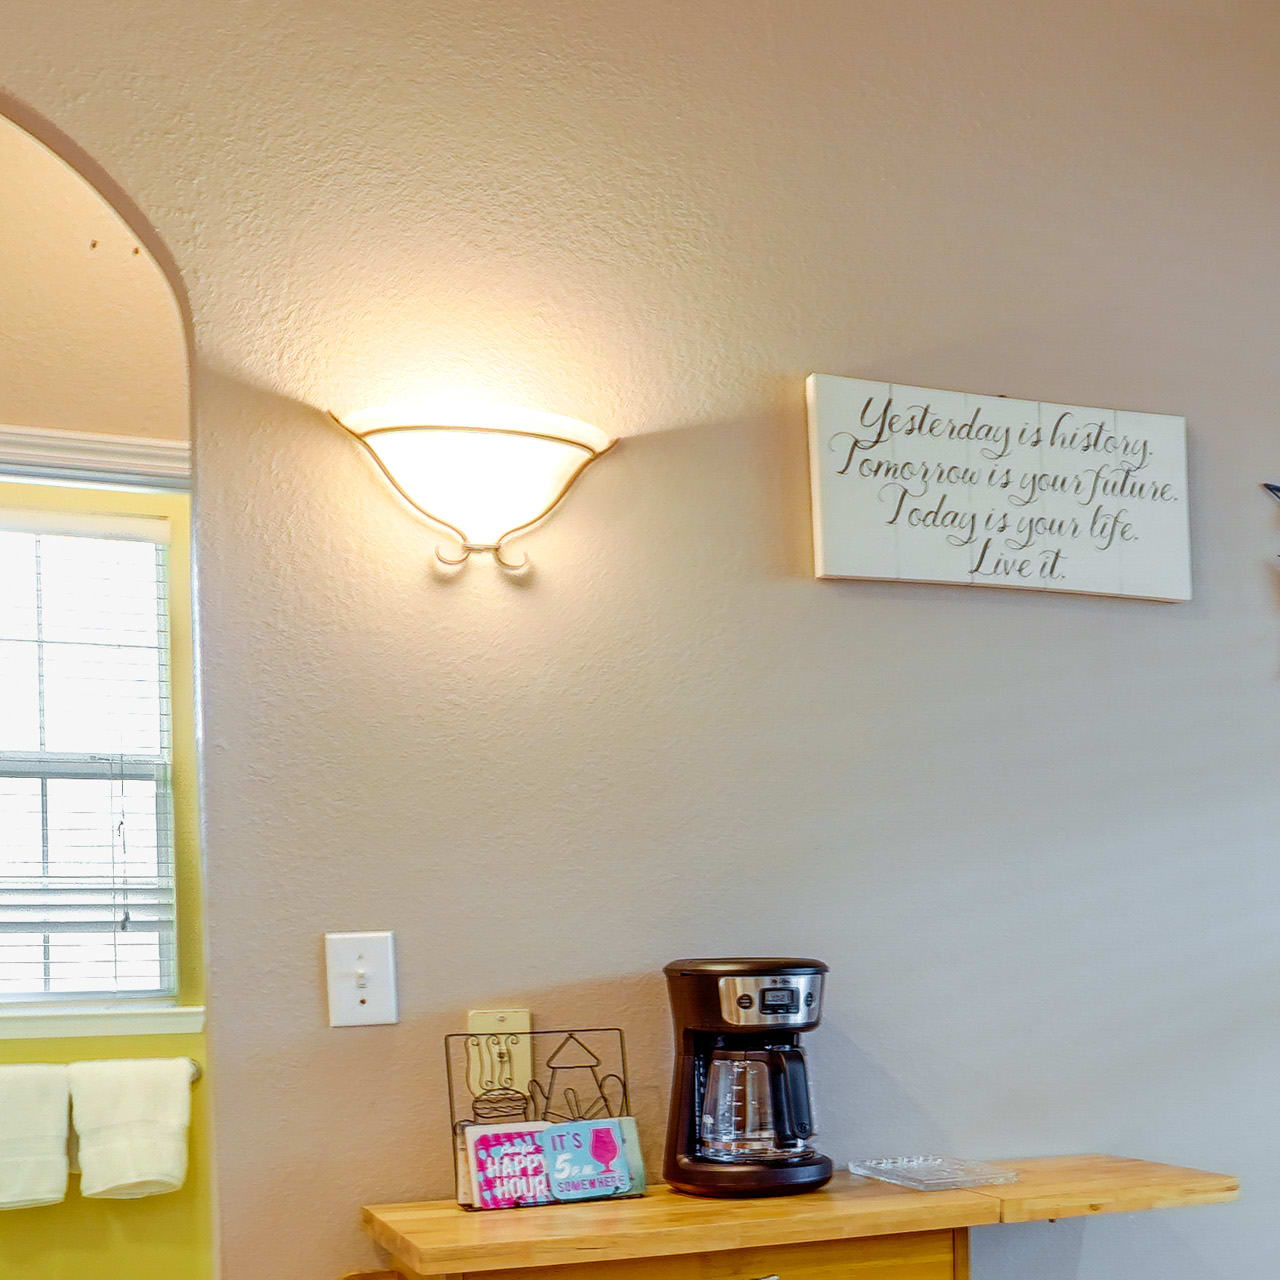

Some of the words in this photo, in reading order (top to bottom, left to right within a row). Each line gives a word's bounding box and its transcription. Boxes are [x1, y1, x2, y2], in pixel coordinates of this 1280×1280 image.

[857, 397, 1011, 460] Yesterday
[1018, 422, 1042, 447] is
[1050, 412, 1152, 470] history.
[829, 432, 979, 490] Tomorrow
[988, 464, 1011, 488] is
[1008, 472, 1082, 506] your
[1078, 464, 1178, 505] future.
[879, 482, 977, 546] Today
[985, 508, 1009, 533] is
[1004, 514, 1081, 551] your
[1089, 505, 1139, 550] life.
[968, 538, 1032, 578] Live
[1039, 549, 1067, 580] it.
[551, 1131, 583, 1151] IT'S
